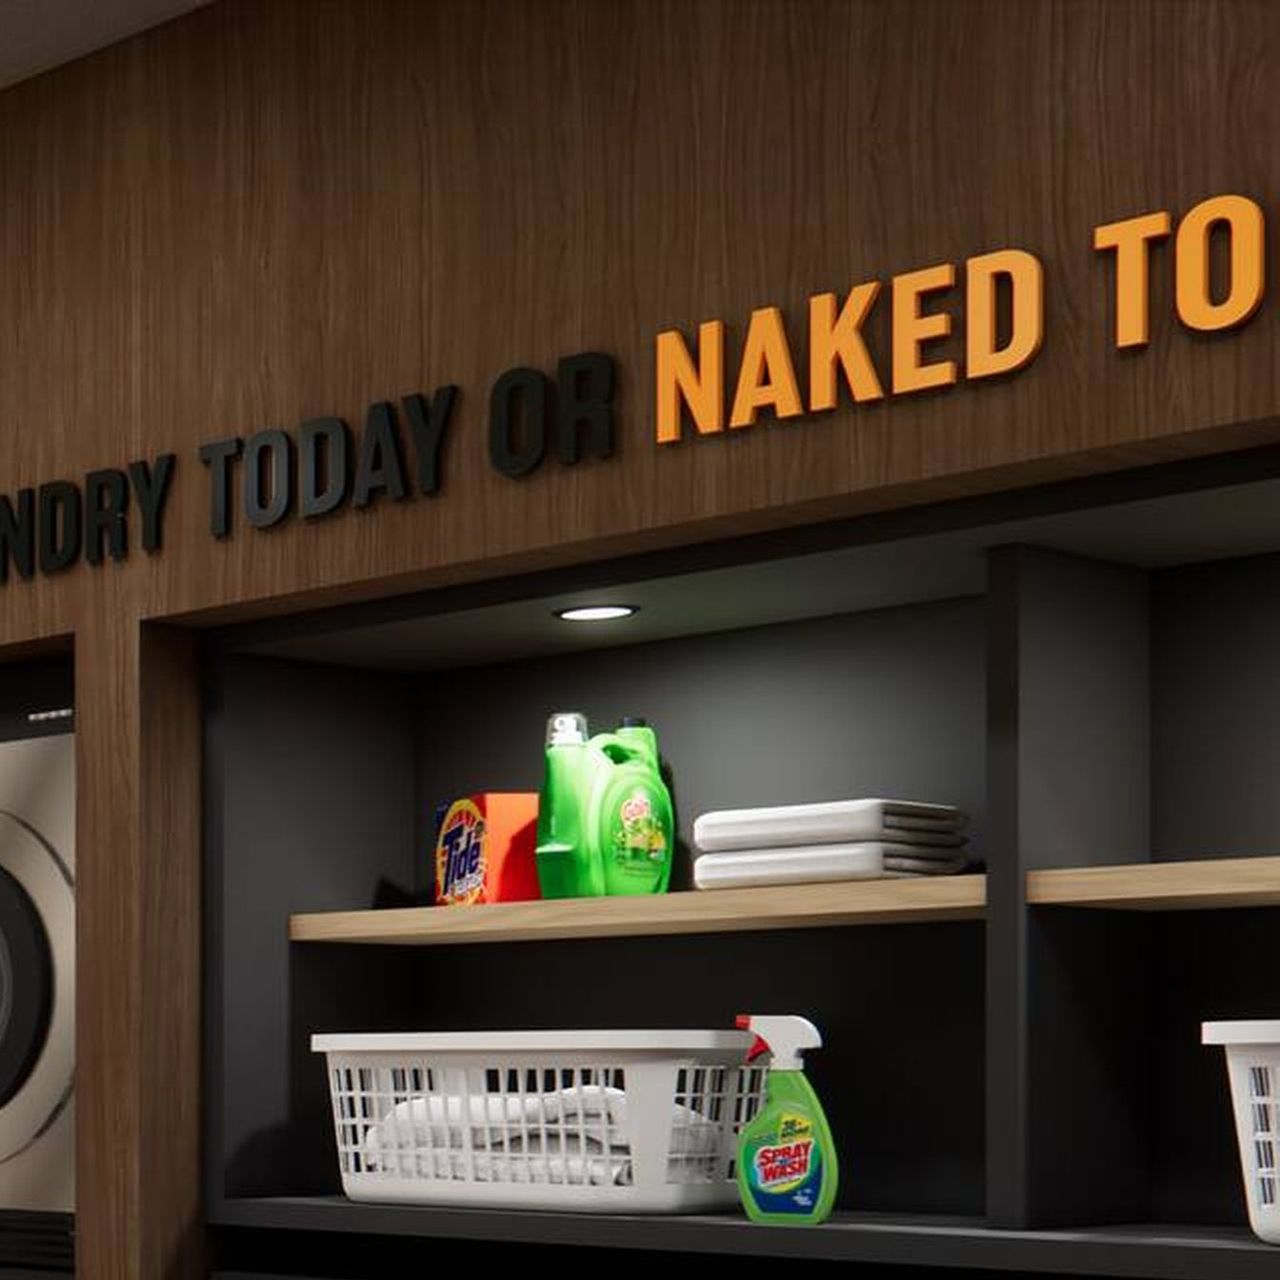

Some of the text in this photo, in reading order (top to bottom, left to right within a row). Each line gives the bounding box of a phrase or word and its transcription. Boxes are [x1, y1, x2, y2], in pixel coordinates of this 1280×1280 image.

[200, 387, 458, 540] TODAY
[488, 351, 616, 479] OR
[655, 248, 1043, 443] NAKED
[1093, 194, 1266, 350] TO
[443, 823, 481, 896] Tide
[758, 1140, 812, 1167] SPRAY
[763, 1157, 808, 1183] WASH
